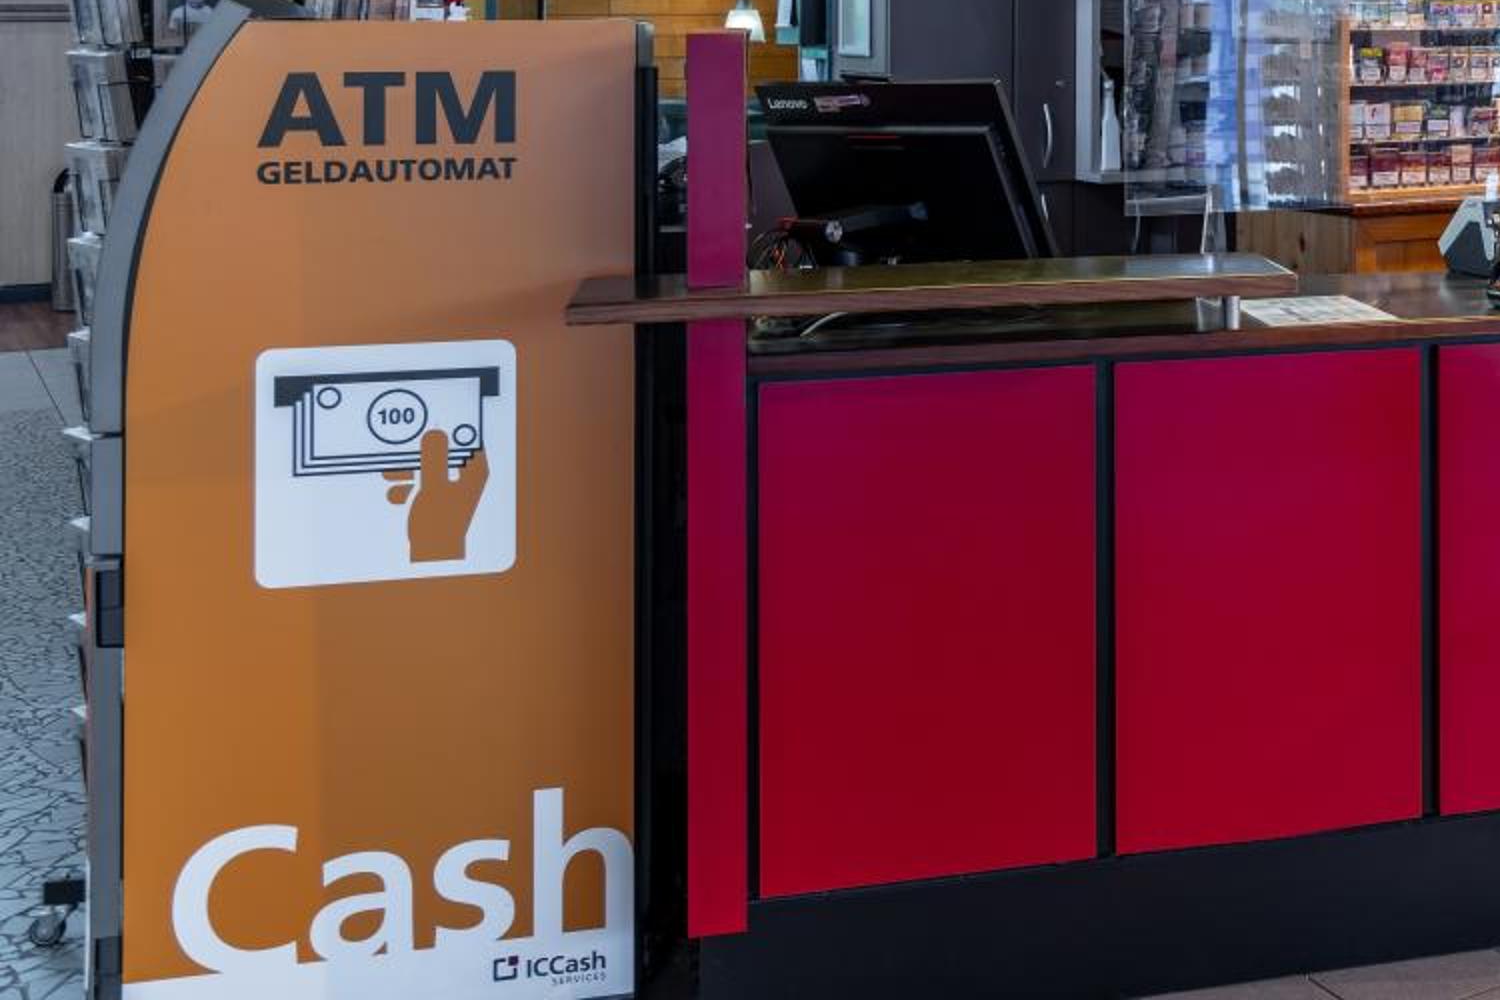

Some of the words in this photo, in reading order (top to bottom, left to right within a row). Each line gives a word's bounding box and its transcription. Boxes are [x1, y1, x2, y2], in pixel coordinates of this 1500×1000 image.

[257, 71, 517, 148] ATM
[768, 97, 808, 109] Lenovo
[256, 156, 517, 186] GELDAUTOMAT
[378, 408, 415, 425] 100
[171, 786, 634, 975] Cash
[527, 951, 607, 978] ICCash
[552, 973, 607, 985] SERVICES
